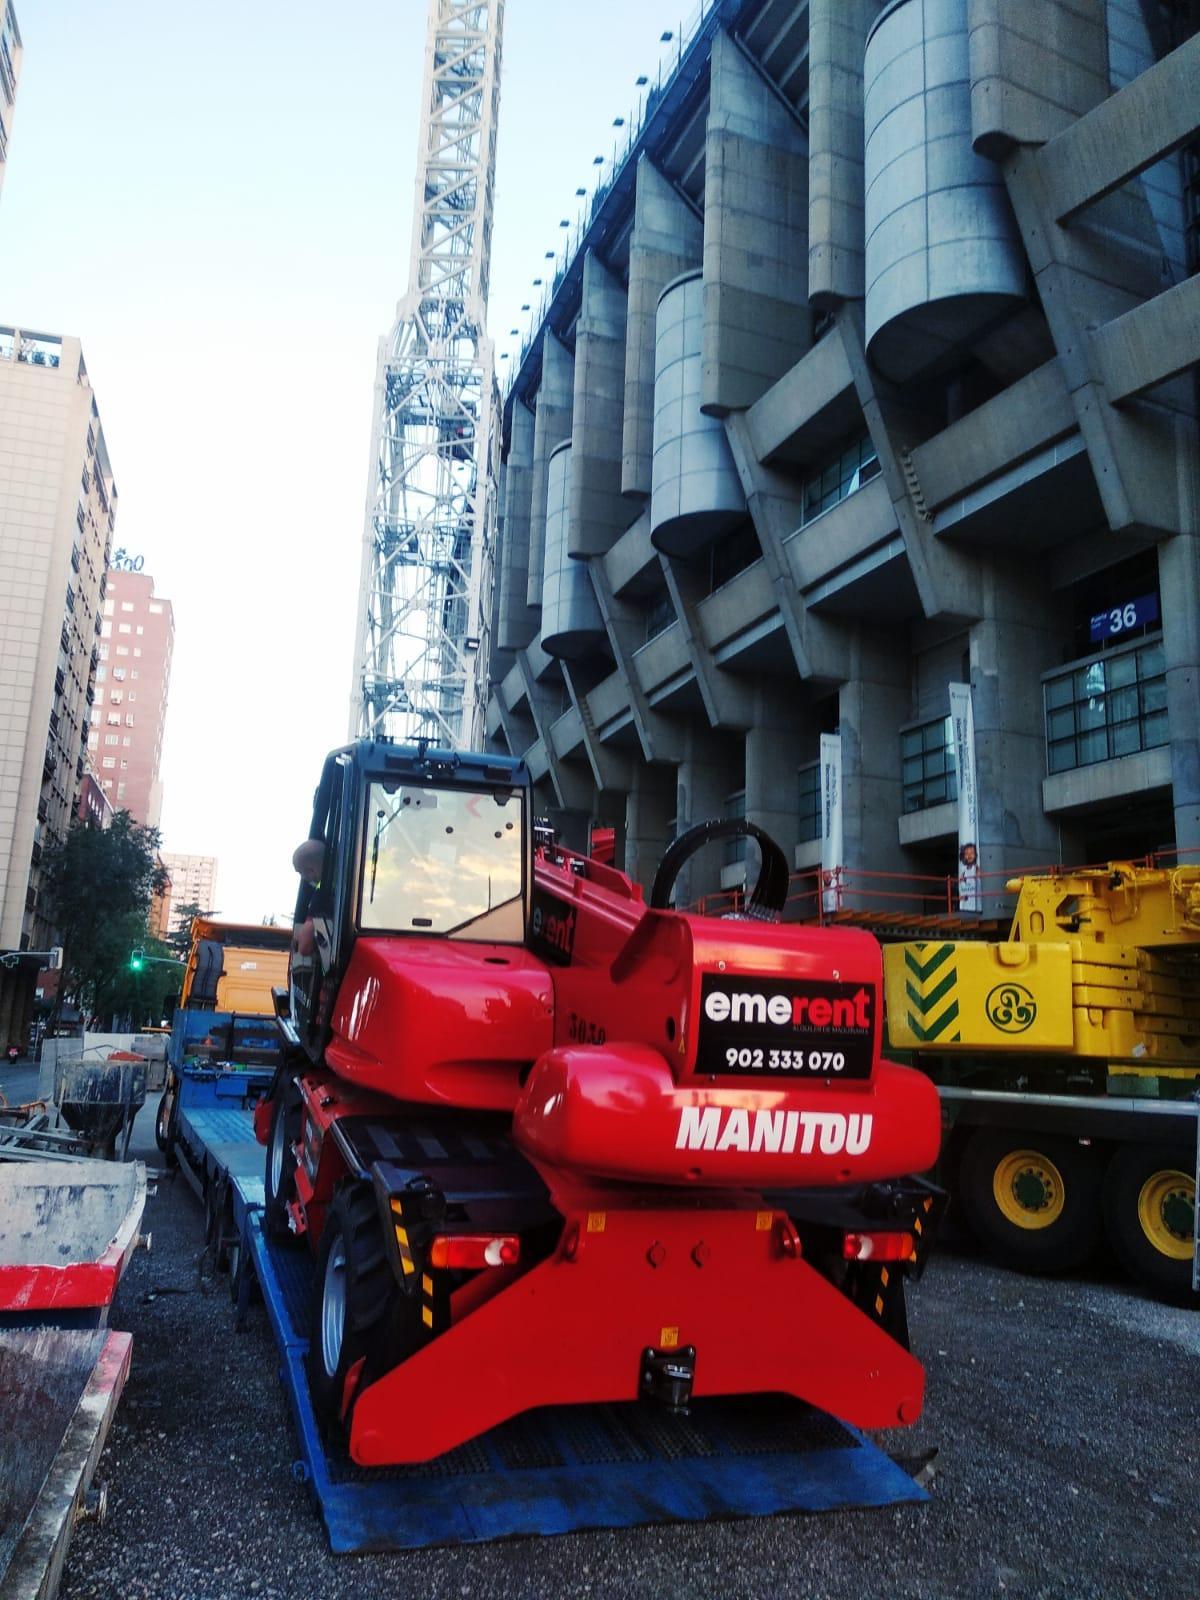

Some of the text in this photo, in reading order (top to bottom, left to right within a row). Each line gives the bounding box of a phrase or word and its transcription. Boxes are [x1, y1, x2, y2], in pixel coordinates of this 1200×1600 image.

[1110, 603, 1137, 632] 36
[704, 987, 871, 1028] emerent
[725, 1048, 845, 1072] 902 333 070
[675, 1106, 873, 1156] MANITOU
